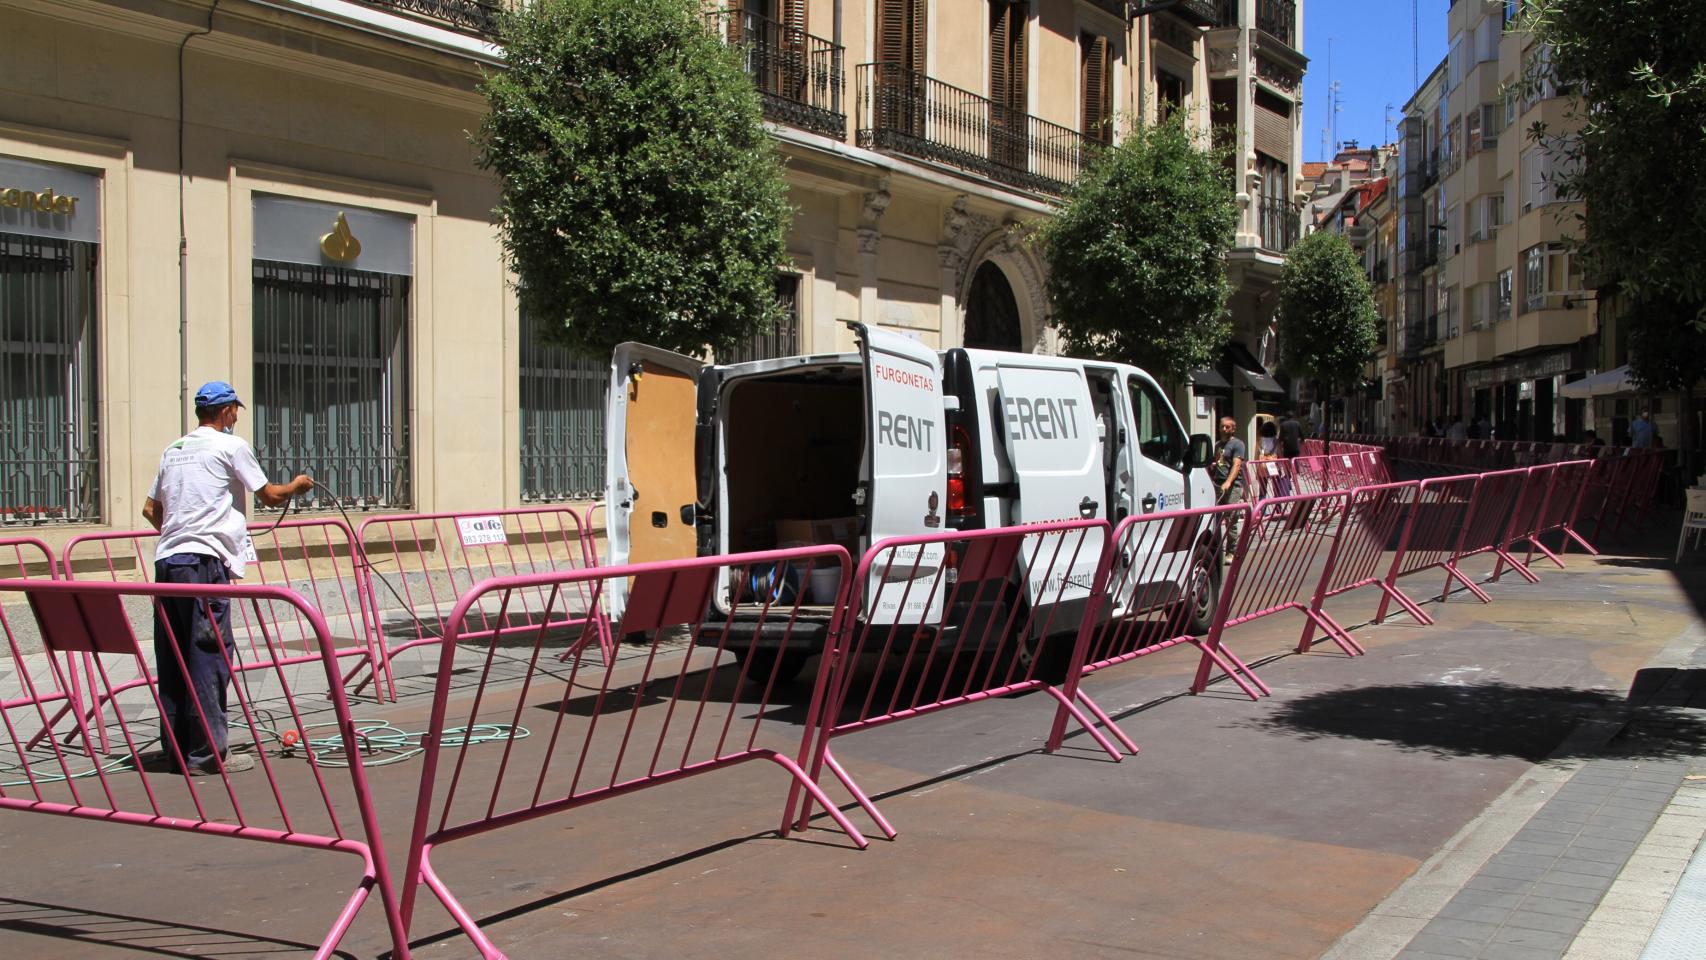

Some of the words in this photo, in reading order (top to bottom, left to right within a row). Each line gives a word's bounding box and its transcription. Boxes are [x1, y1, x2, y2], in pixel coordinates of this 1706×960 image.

[0, 187, 79, 217] ander
[876, 365, 934, 392] FURGONETAS
[878, 410, 934, 453] RENT
